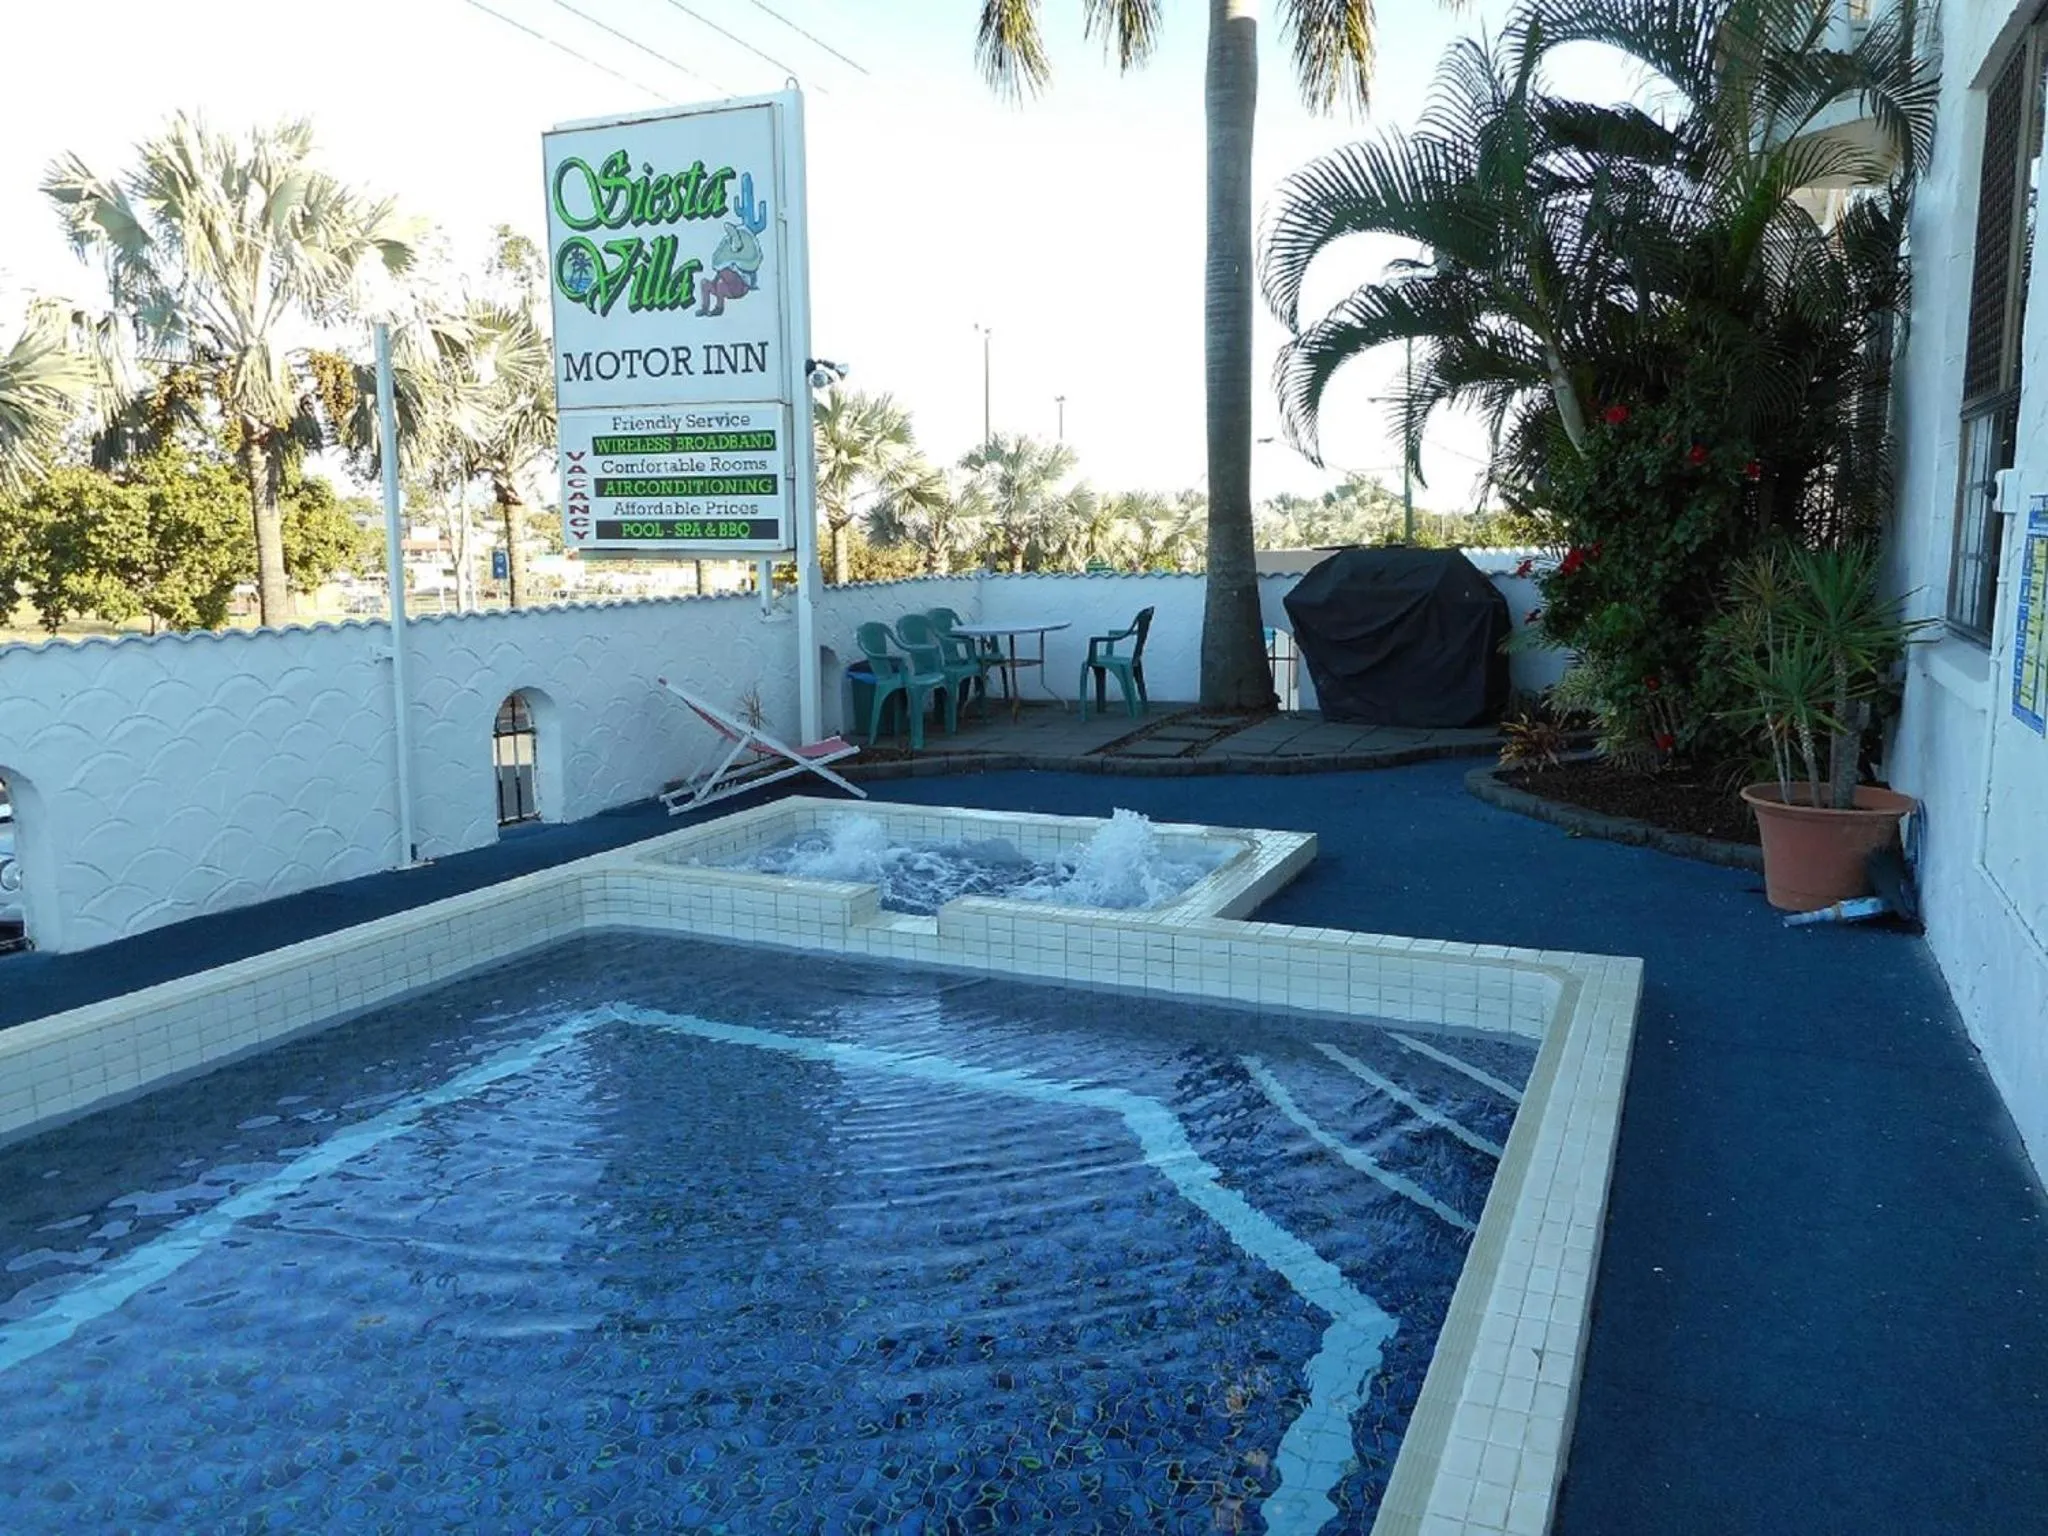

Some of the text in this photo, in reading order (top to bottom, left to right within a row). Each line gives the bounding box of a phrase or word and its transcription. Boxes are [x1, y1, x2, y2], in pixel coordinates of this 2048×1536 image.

[553, 149, 736, 233] Siesta
[556, 233, 703, 317] Villa
[563, 341, 769, 382] MOTOR INN
[612, 412, 751, 432] Friendly Service
[595, 433, 774, 454] WIRELESS BROADBAND
[600, 456, 768, 475] Comfortable Rooms
[566, 451, 590, 540] VACANCY
[603, 478, 773, 496] AIRCONDITIONING
[613, 500, 760, 517] Affordable Prices
[621, 522, 664, 537] POOL
[674, 523, 702, 537] SPA
[706, 523, 717, 537] &
